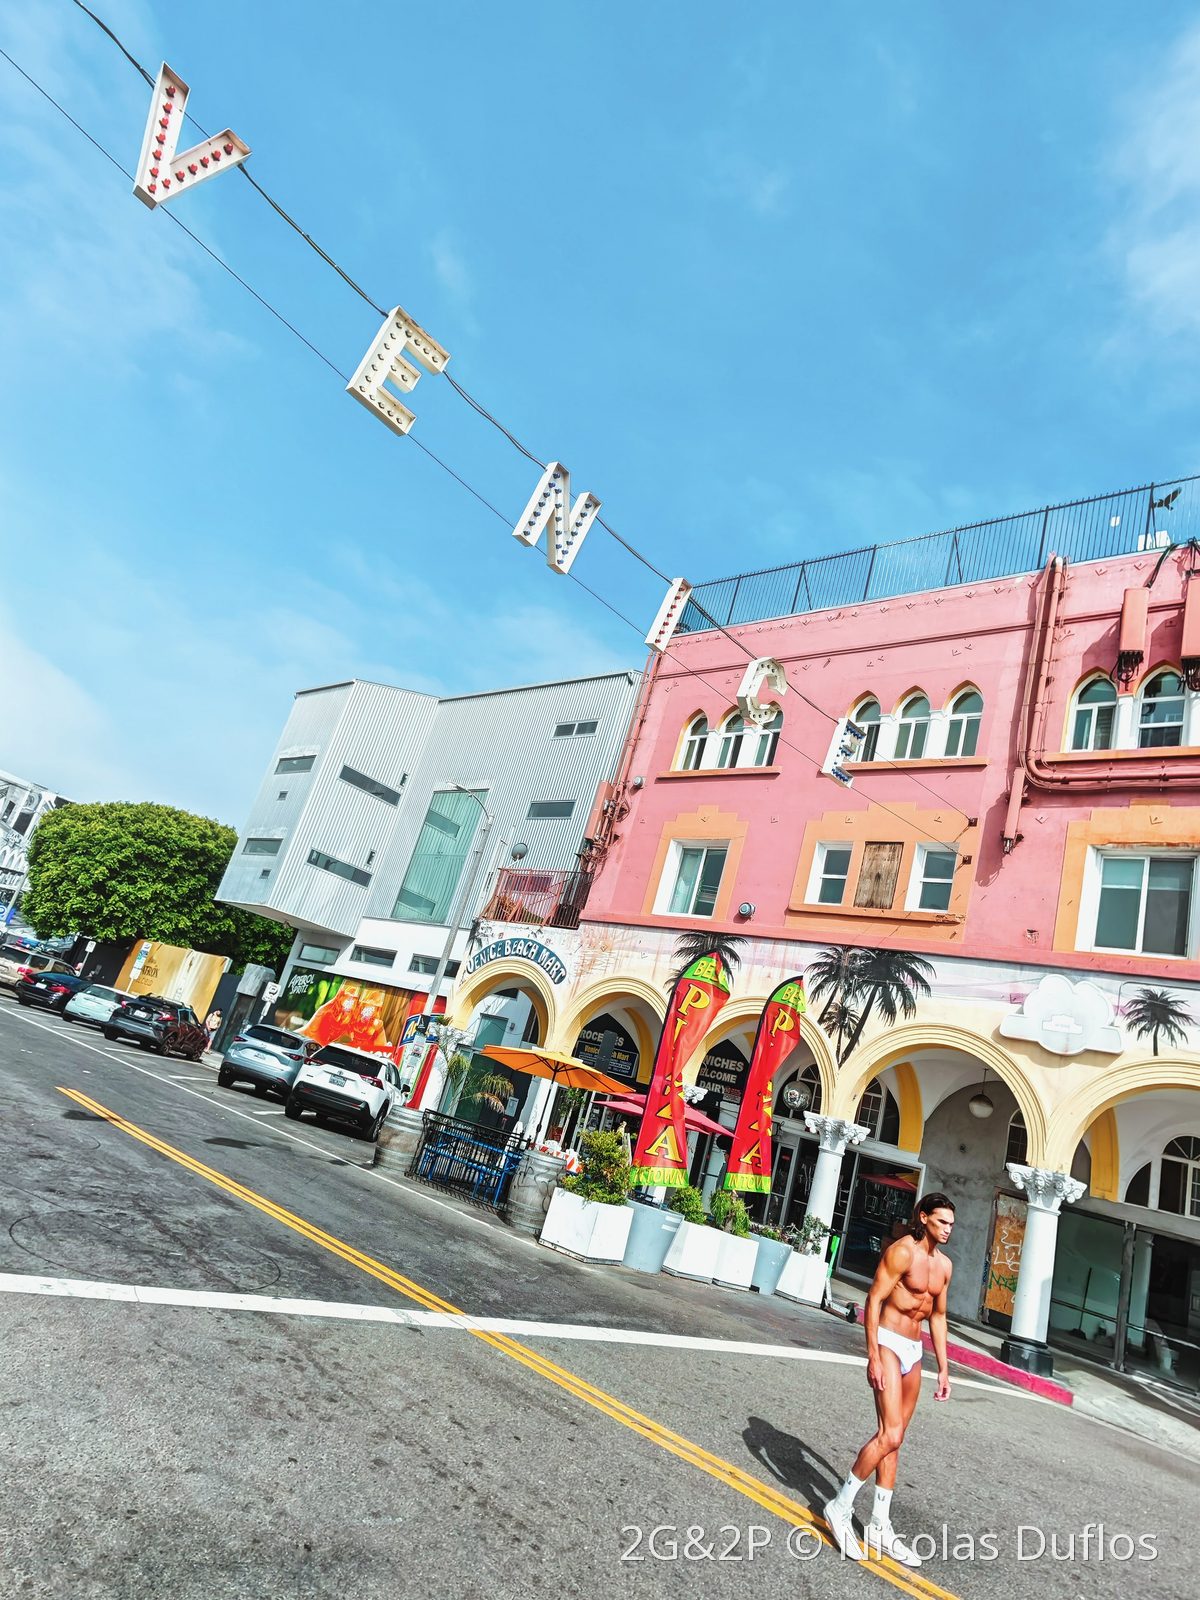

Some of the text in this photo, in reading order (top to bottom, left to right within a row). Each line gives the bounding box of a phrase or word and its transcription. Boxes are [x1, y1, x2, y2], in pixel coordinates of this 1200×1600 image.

[132, 60, 866, 788] VENICE
[504, 940, 540, 962] BEACH
[538, 948, 566, 984] MART
